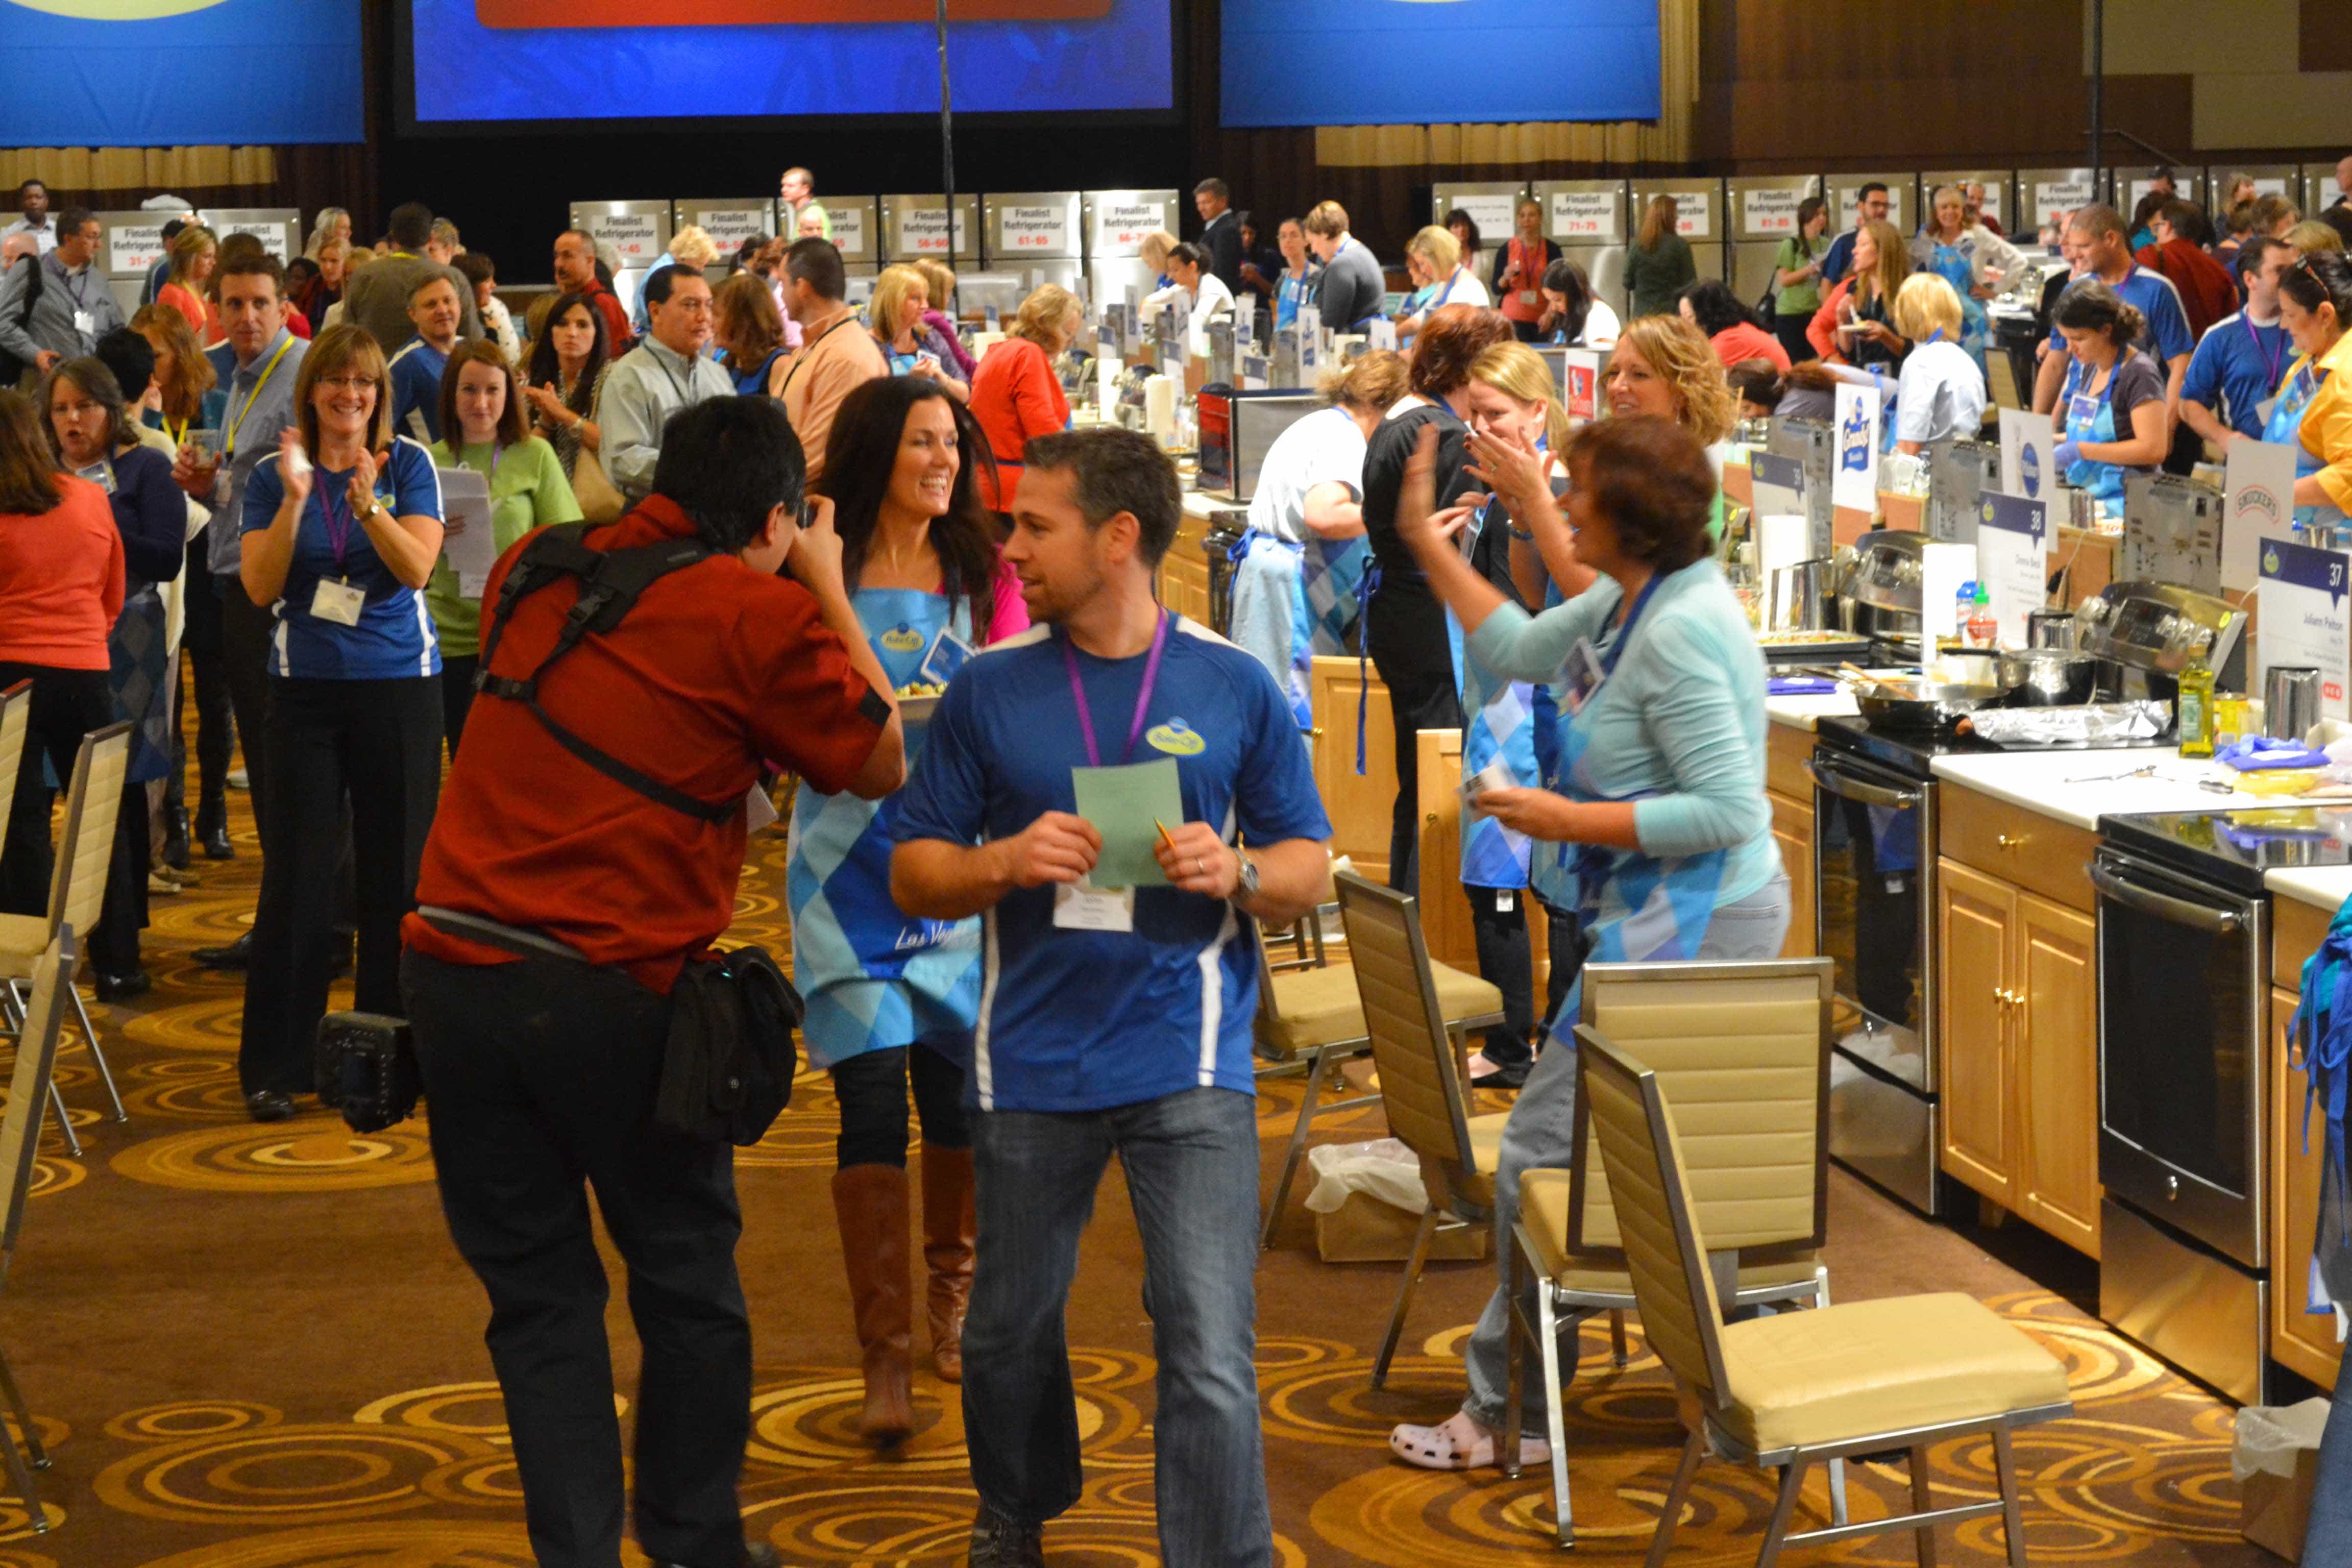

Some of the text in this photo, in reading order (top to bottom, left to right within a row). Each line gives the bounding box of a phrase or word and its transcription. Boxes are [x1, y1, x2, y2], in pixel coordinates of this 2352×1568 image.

[2049, 184, 2082, 193] Finalist
[1566, 195, 1600, 204] Finalist
[1758, 192, 1792, 200] Finalist
[1015, 208, 1050, 218] Finalist
[1115, 206, 1150, 215] Finalist
[1555, 207, 1611, 216] Refrigerator
[606, 216, 643, 226] Finalist
[712, 212, 747, 222] Finalist
[1004, 220, 1062, 231] Refrigerator
[1104, 218, 1162, 229] Refrigerator
[1569, 221, 1597, 231] 71-75
[595, 229, 654, 240] Refrigerator
[1119, 232, 1145, 242] 66-7
[1018, 236, 1049, 246] 61-65
[2030, 509, 2042, 532] 38
[2329, 562, 2343, 587] 37
[895, 926, 926, 950] Las
